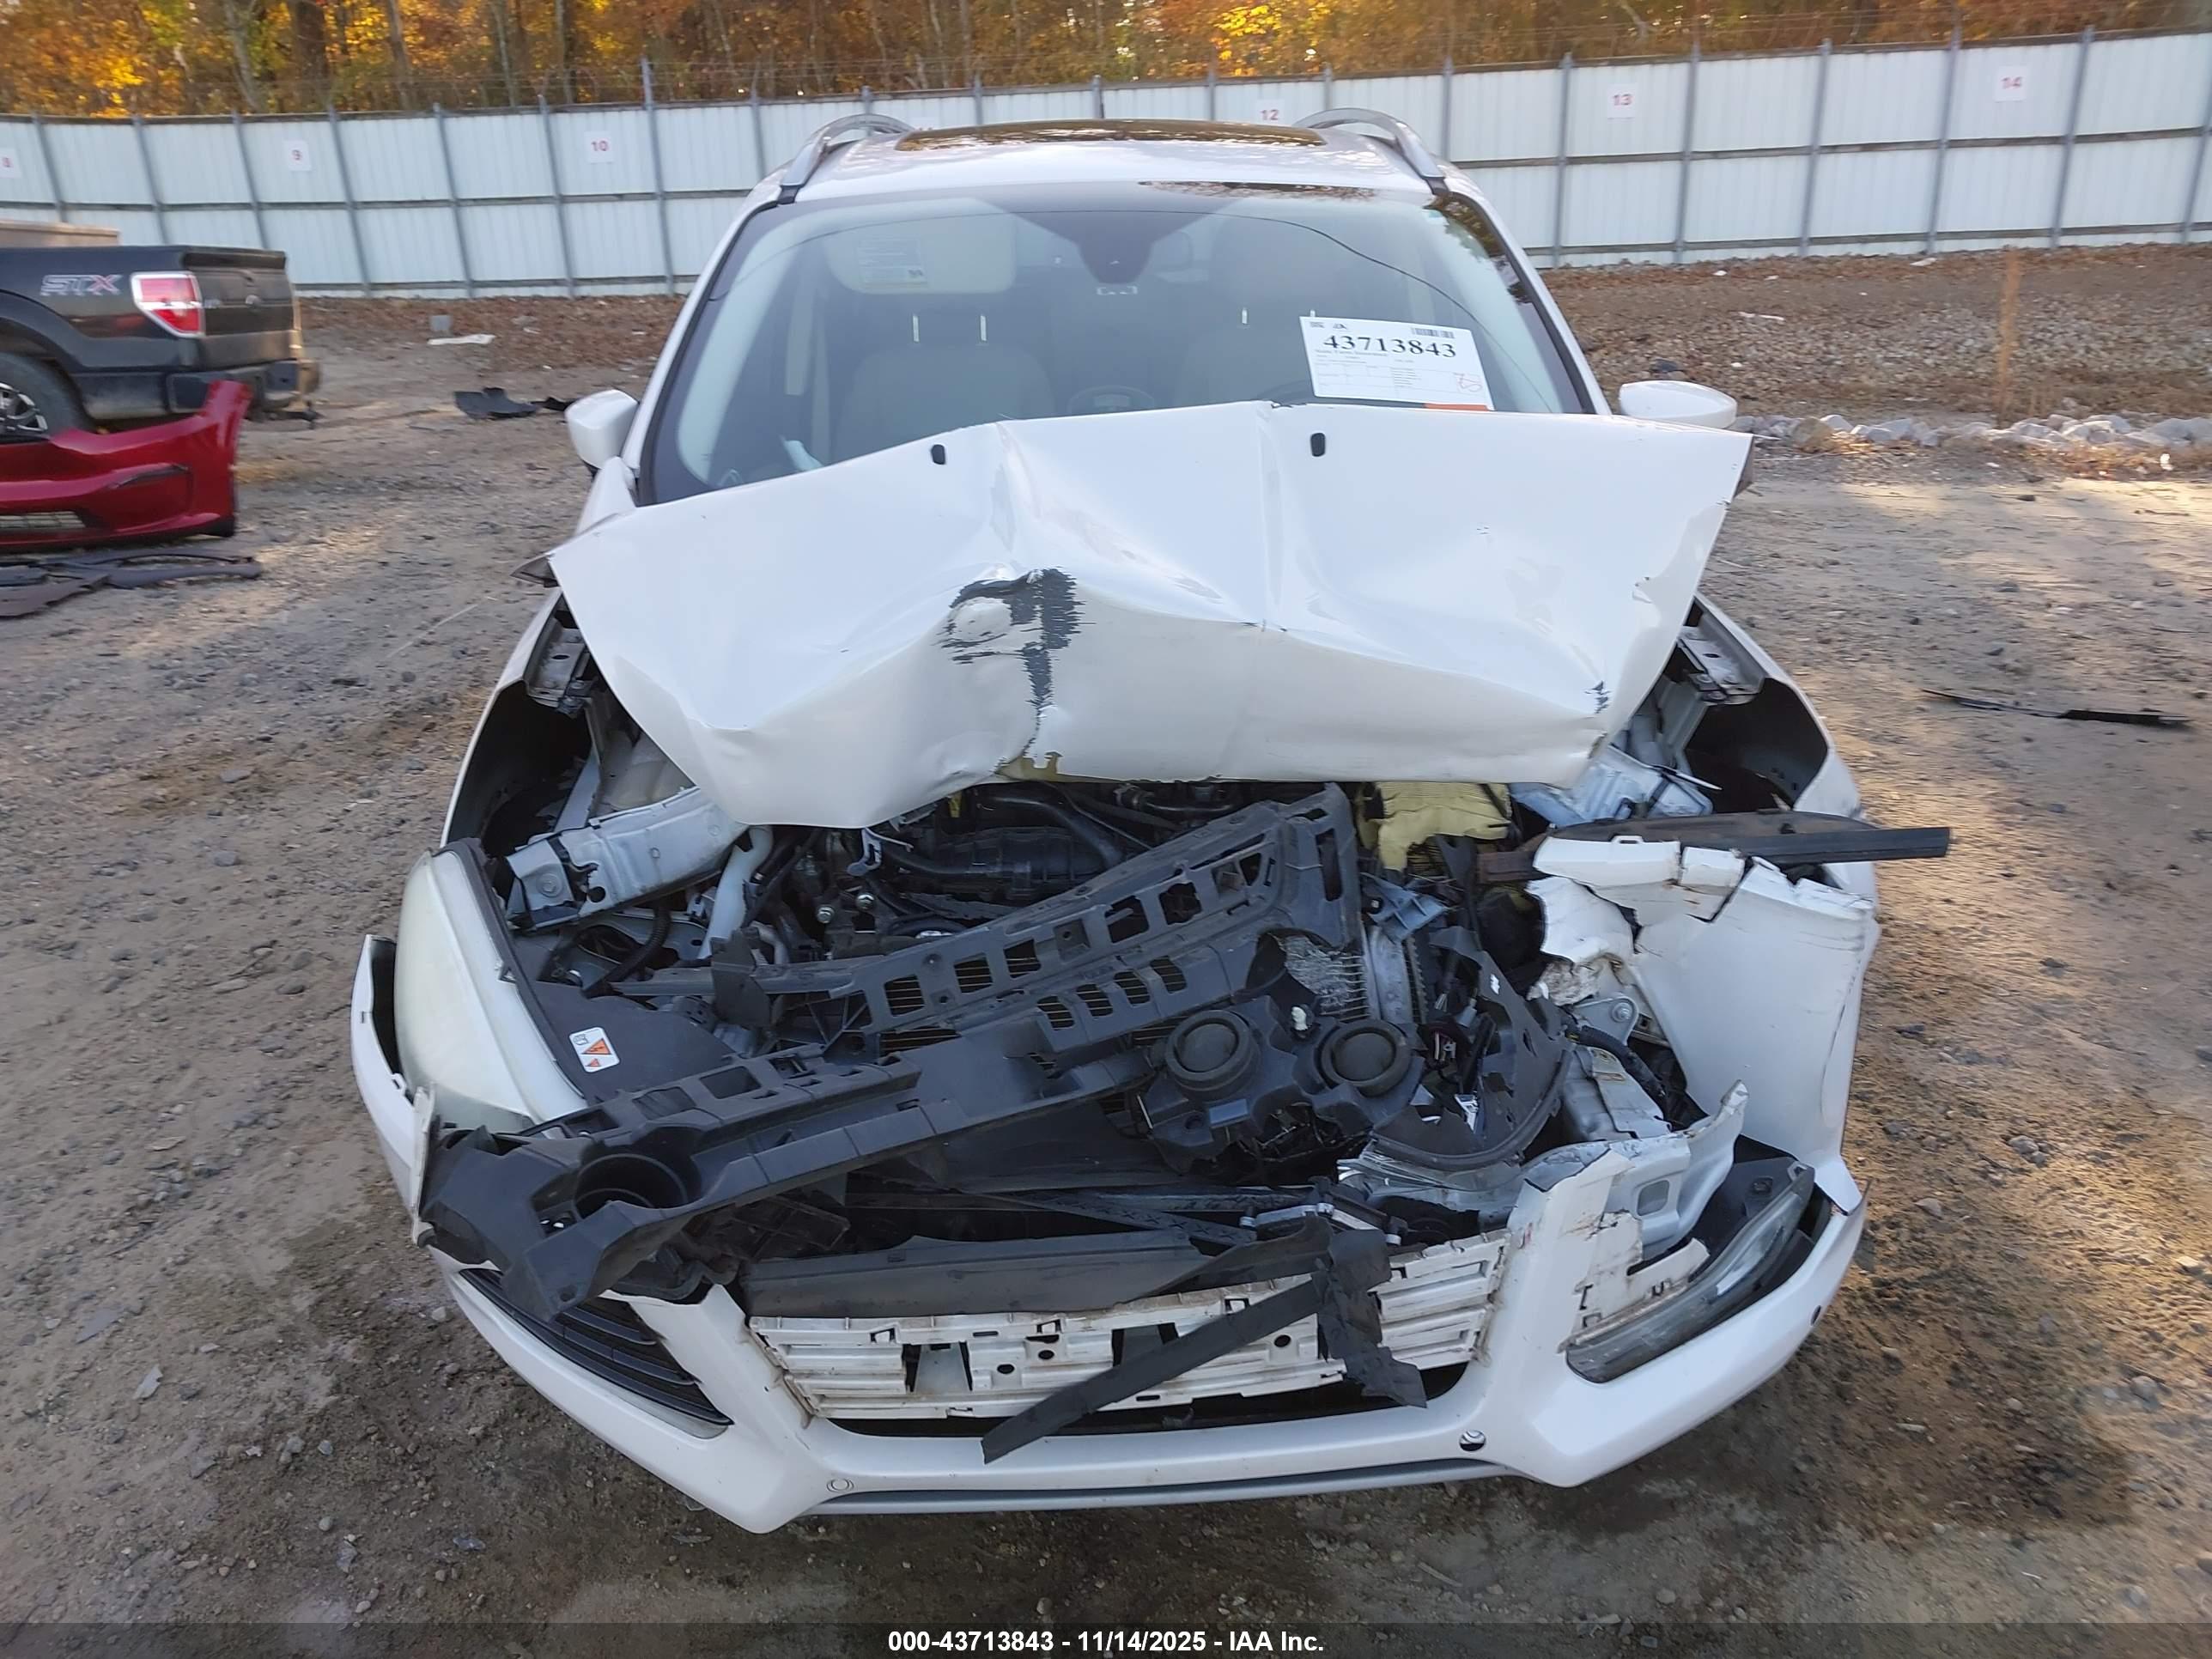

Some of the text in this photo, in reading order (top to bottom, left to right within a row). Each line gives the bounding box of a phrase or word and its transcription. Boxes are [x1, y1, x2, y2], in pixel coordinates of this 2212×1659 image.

[2002, 76, 2021, 89] 14
[1613, 94, 1632, 106] 13
[1261, 109, 1279, 120] 12
[592, 140, 609, 152] 10
[41, 274, 123, 293] STX
[1323, 335, 1455, 357] 43713843
